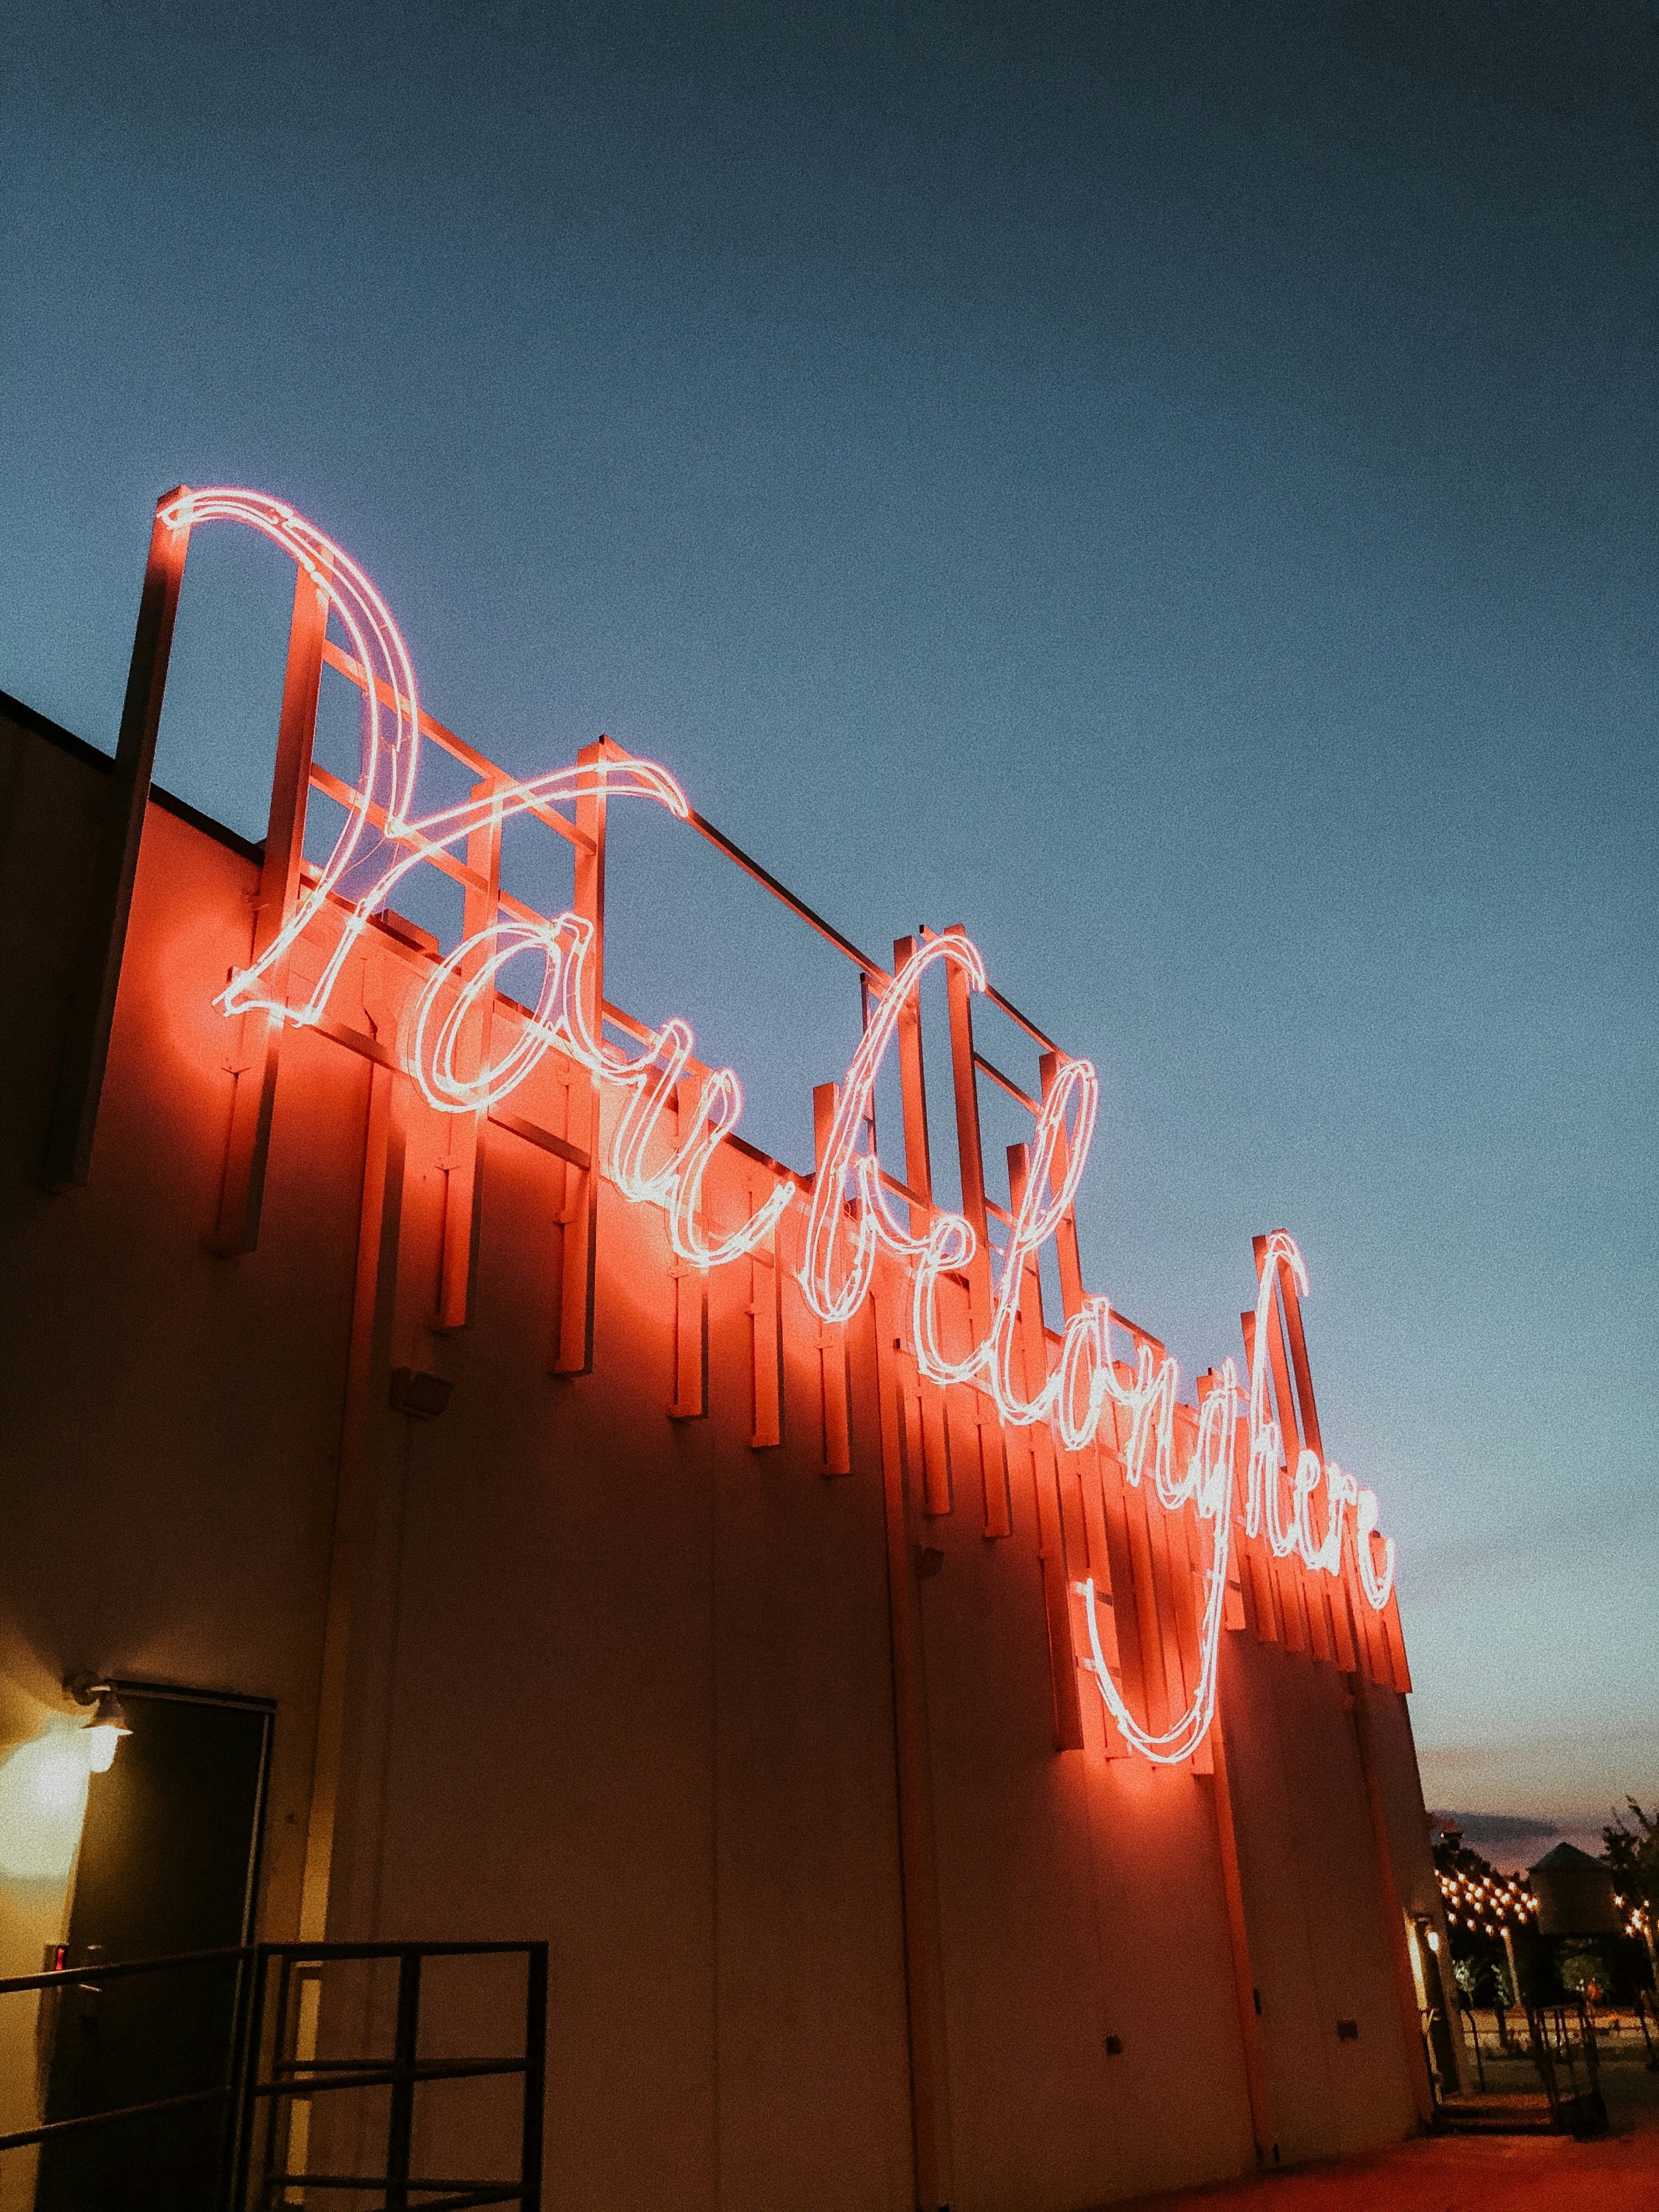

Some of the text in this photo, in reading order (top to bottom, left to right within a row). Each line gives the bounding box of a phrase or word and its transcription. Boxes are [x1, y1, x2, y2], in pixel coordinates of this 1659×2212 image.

[155, 486, 1396, 1765] You belong here
